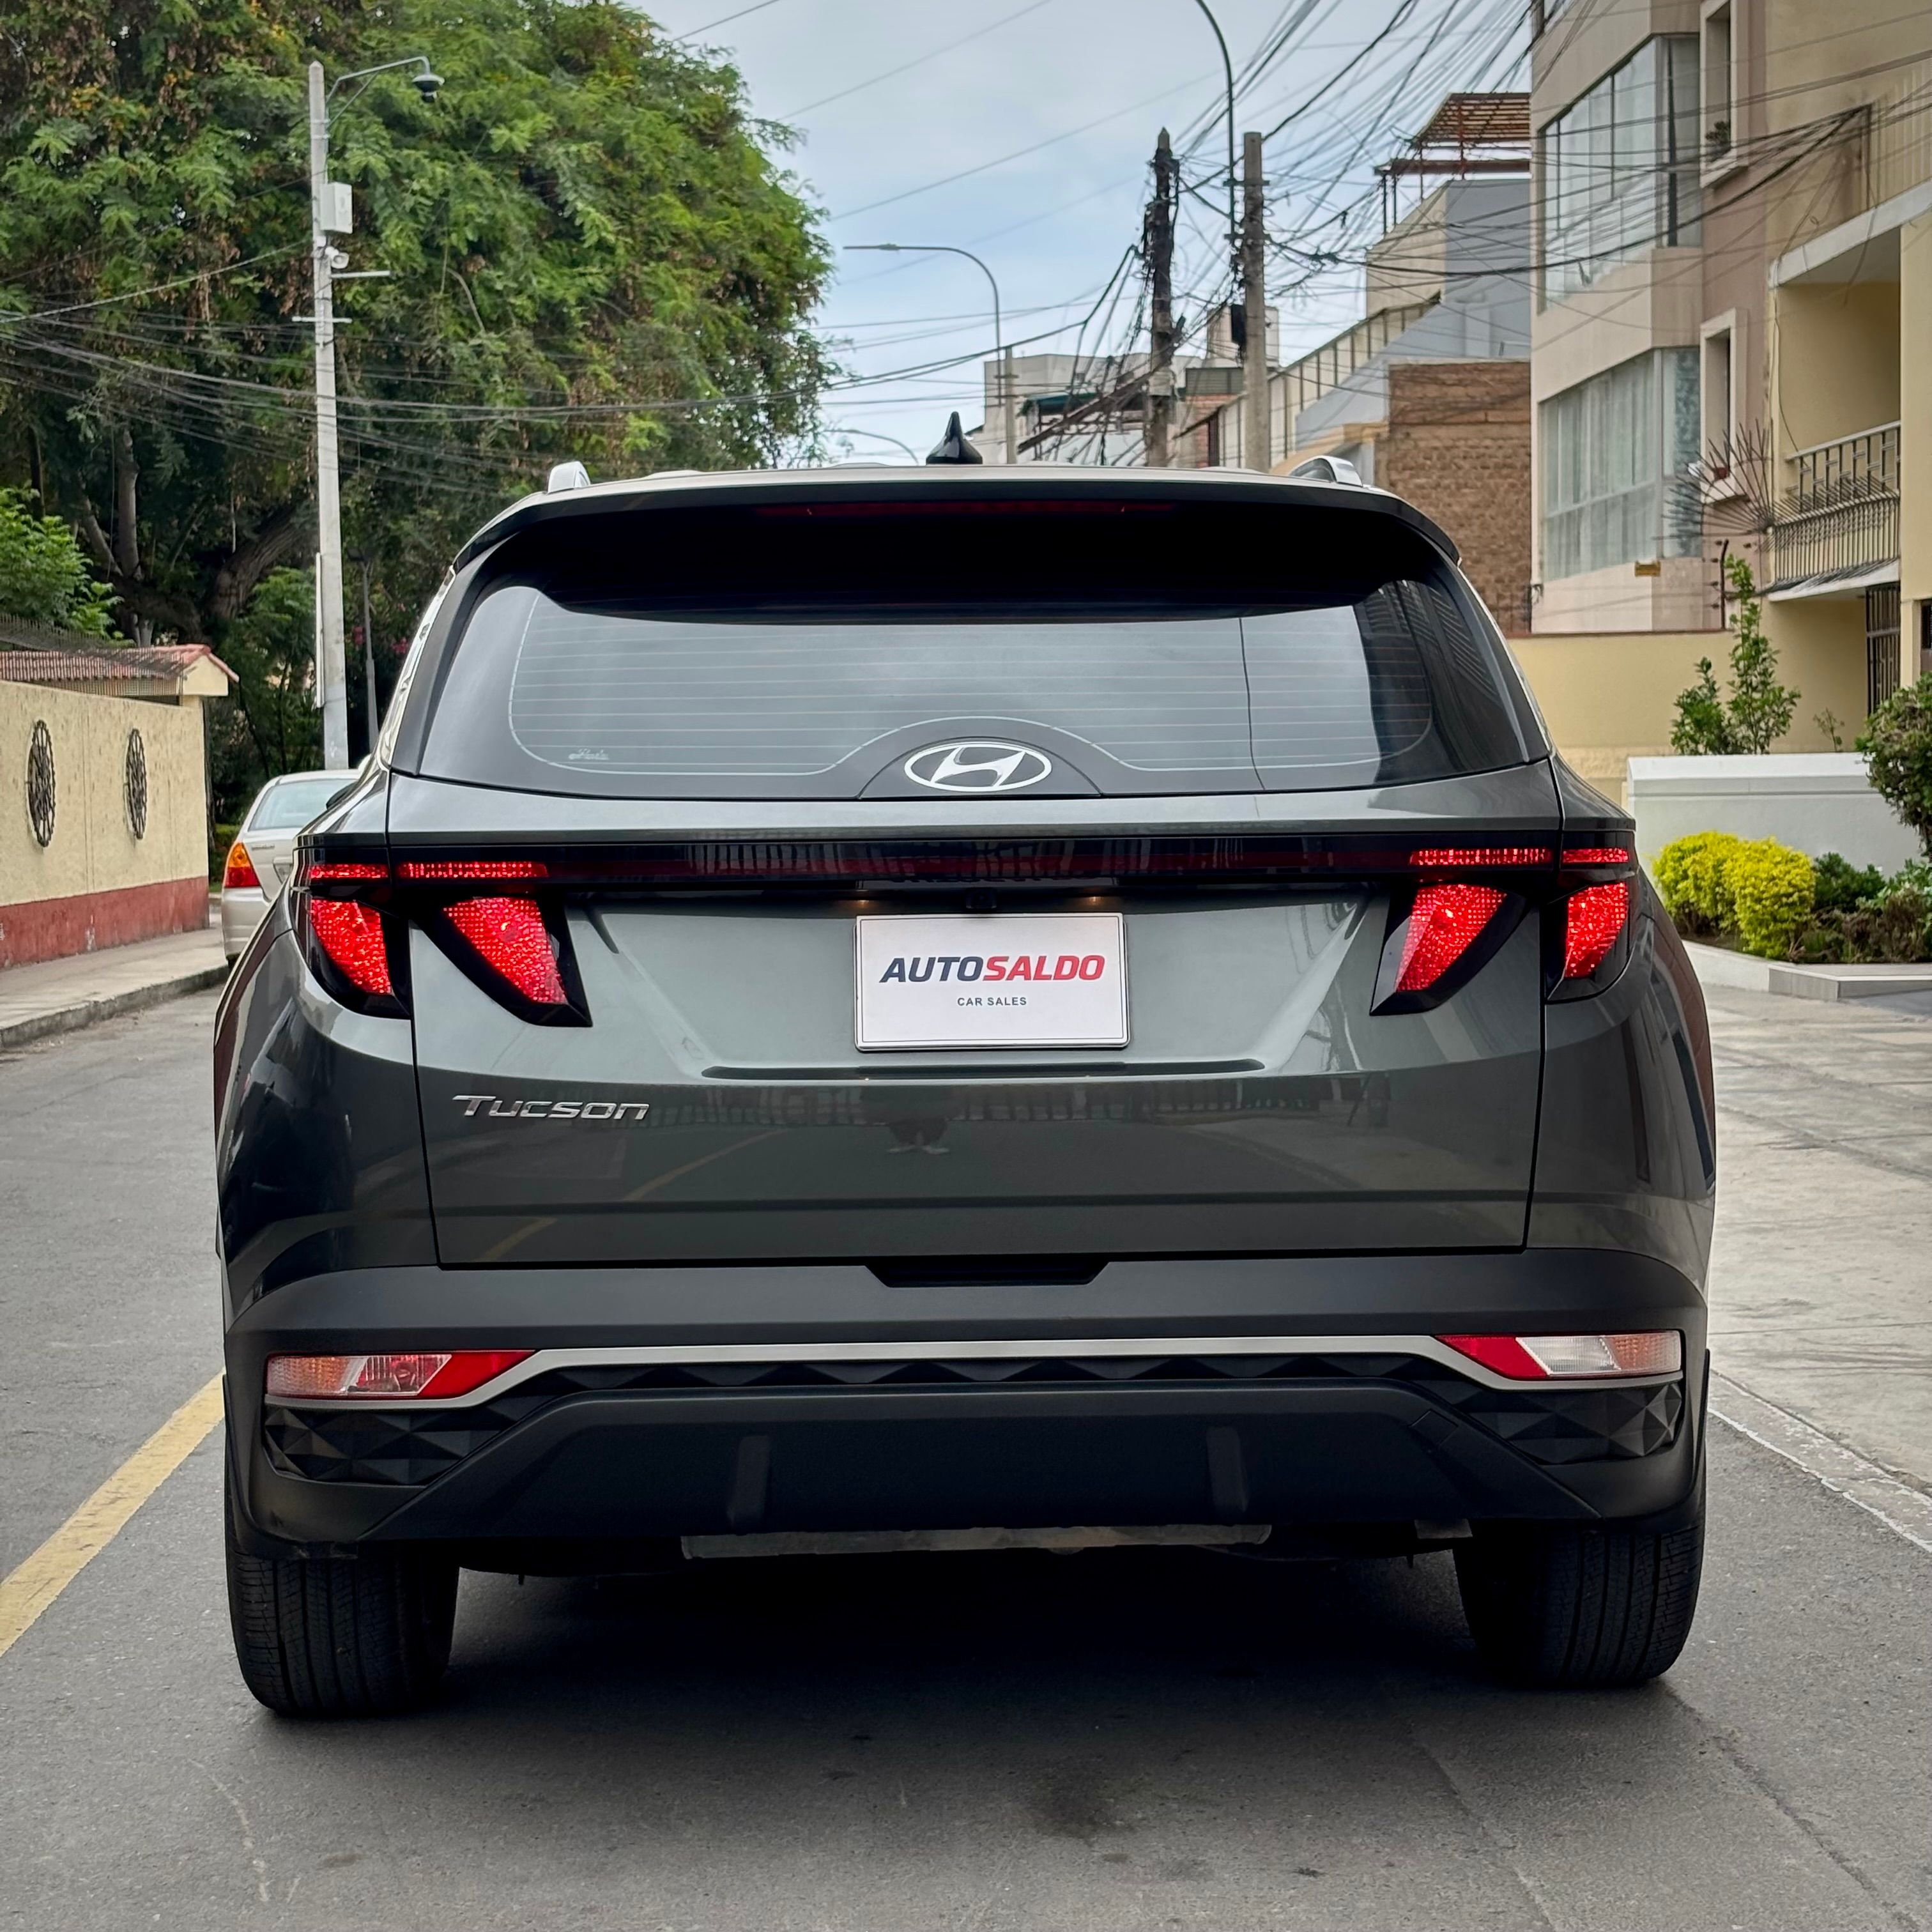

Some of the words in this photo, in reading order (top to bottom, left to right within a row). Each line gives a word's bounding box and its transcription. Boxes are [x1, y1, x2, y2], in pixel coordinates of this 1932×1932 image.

[879, 955, 1105, 983] AUTOSALDO
[957, 997, 983, 1006] CAR
[987, 997, 1027, 1006] SALES
